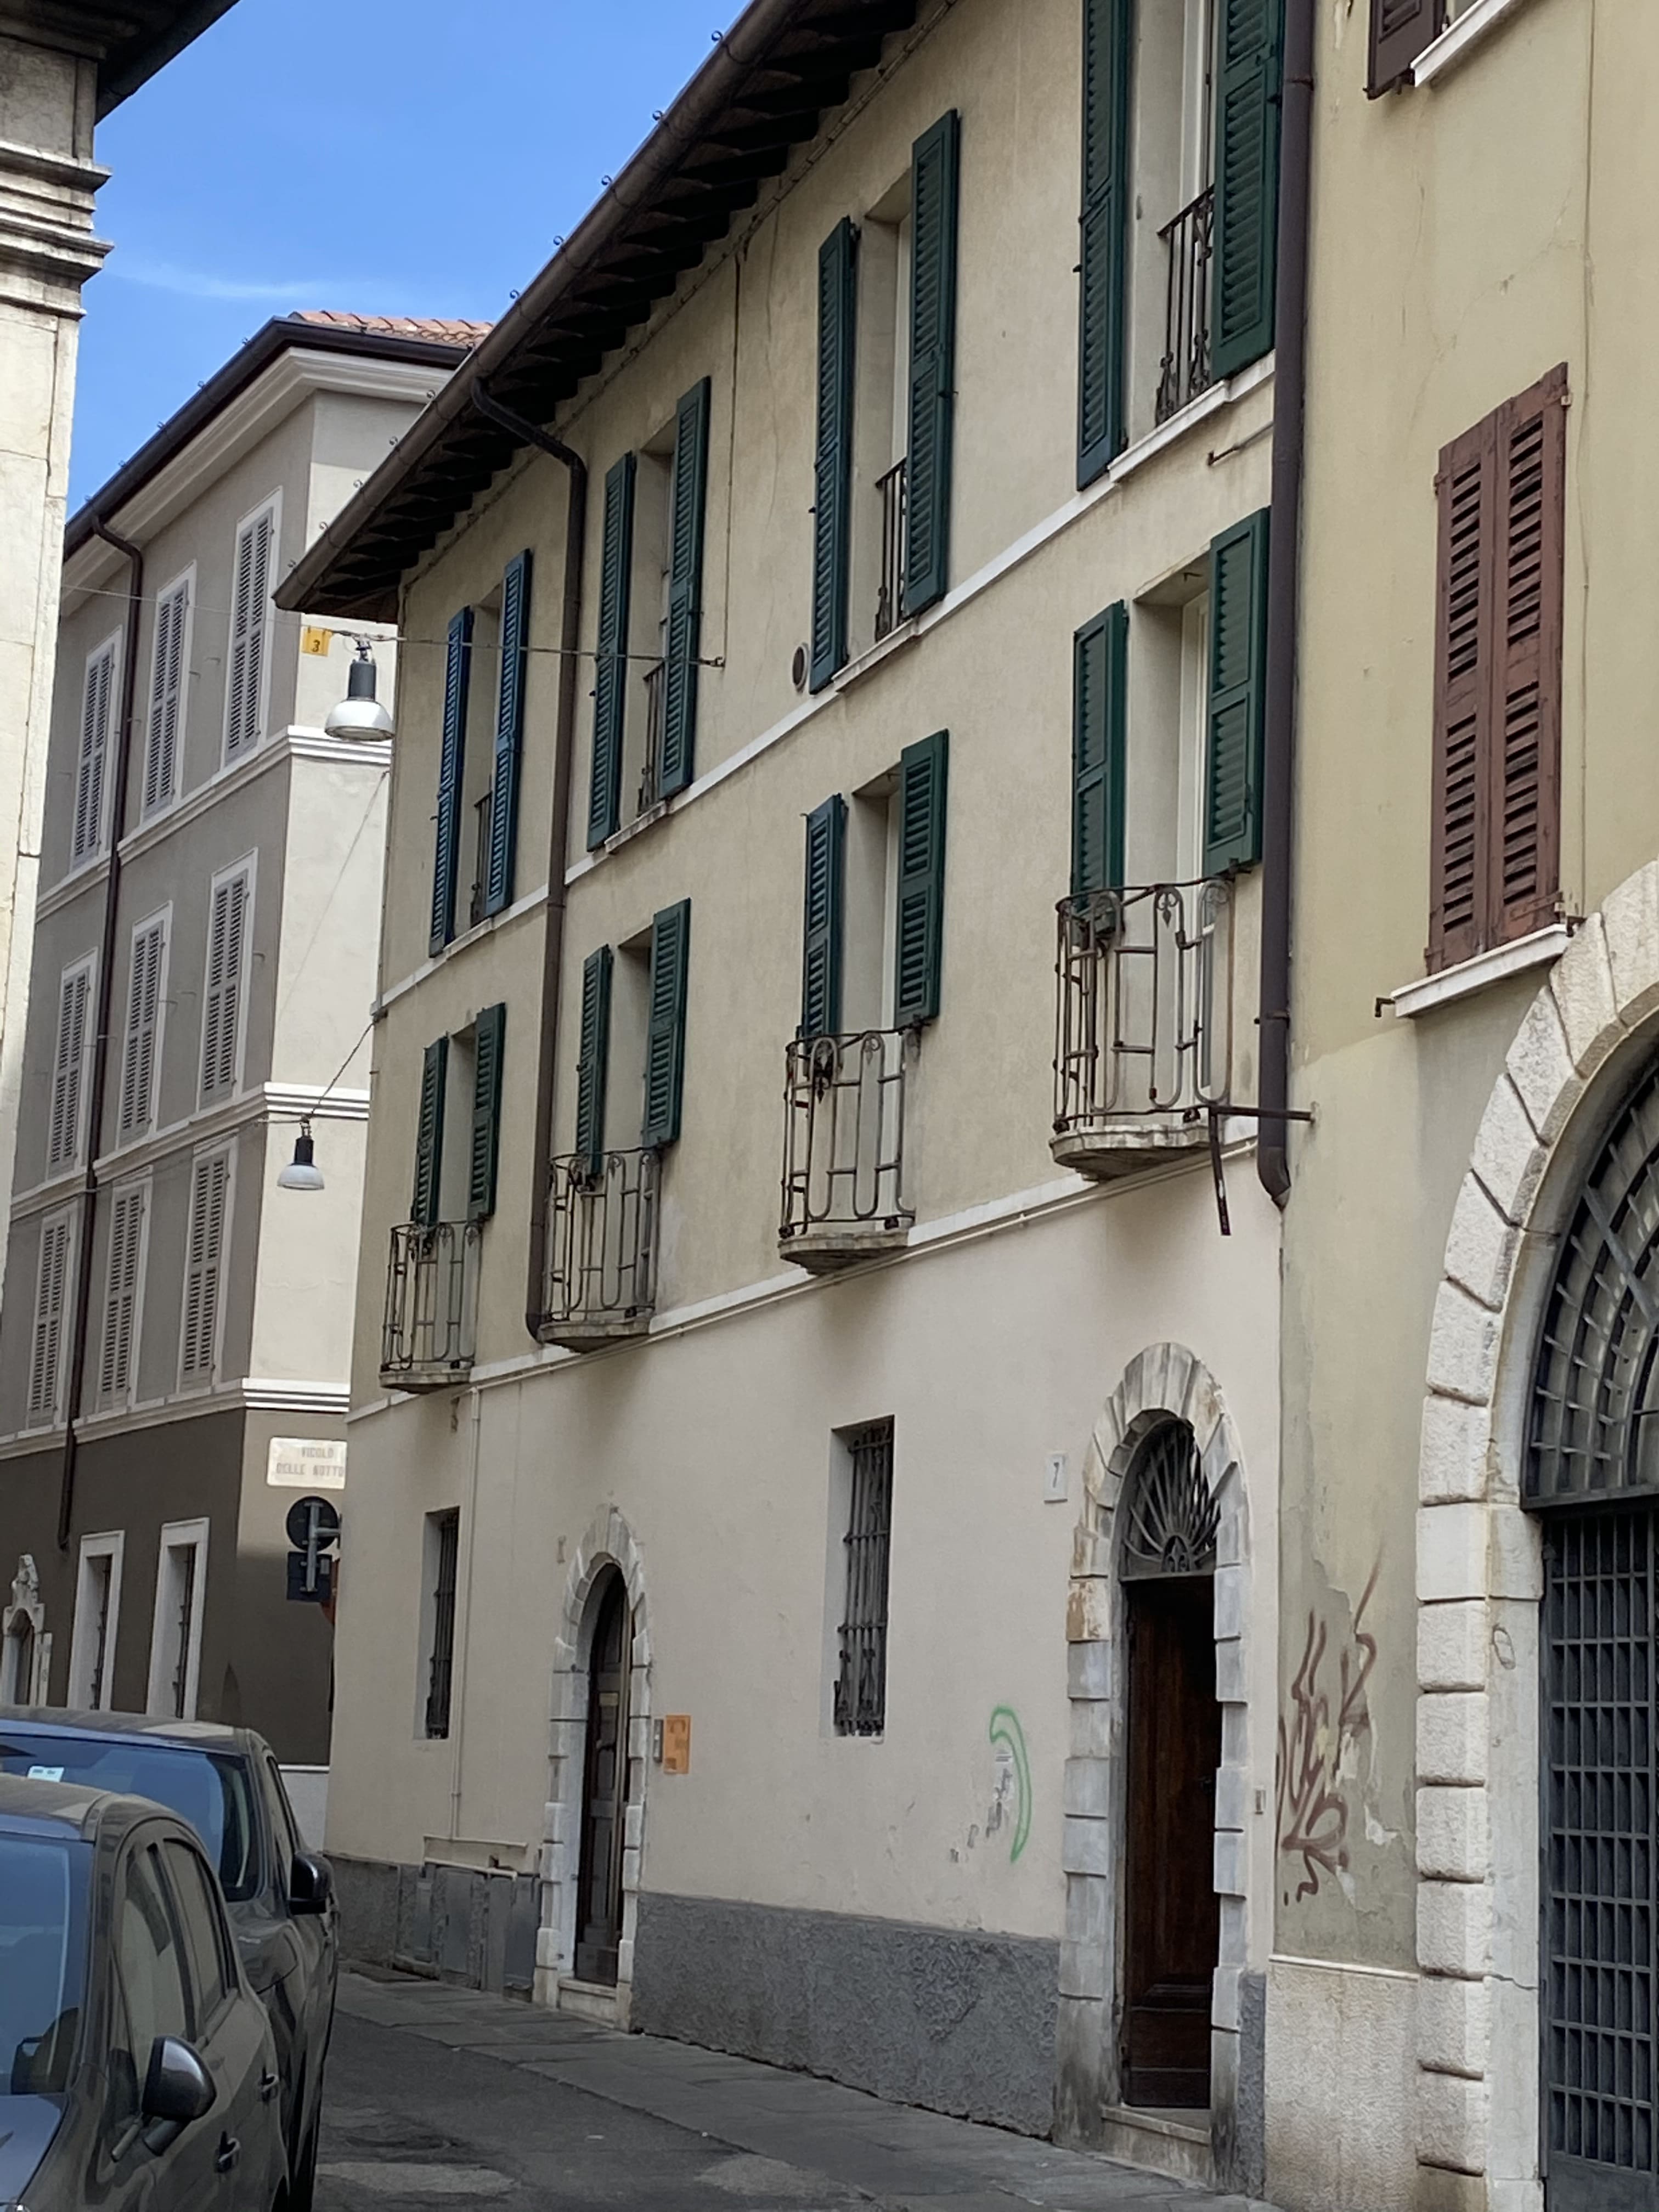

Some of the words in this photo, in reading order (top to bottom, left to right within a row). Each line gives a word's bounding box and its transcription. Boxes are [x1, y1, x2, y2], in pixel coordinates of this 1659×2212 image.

[312, 639, 320, 652] 3
[301, 1447, 334, 1458] VICOLO
[276, 1463, 306, 1475] DELLE
